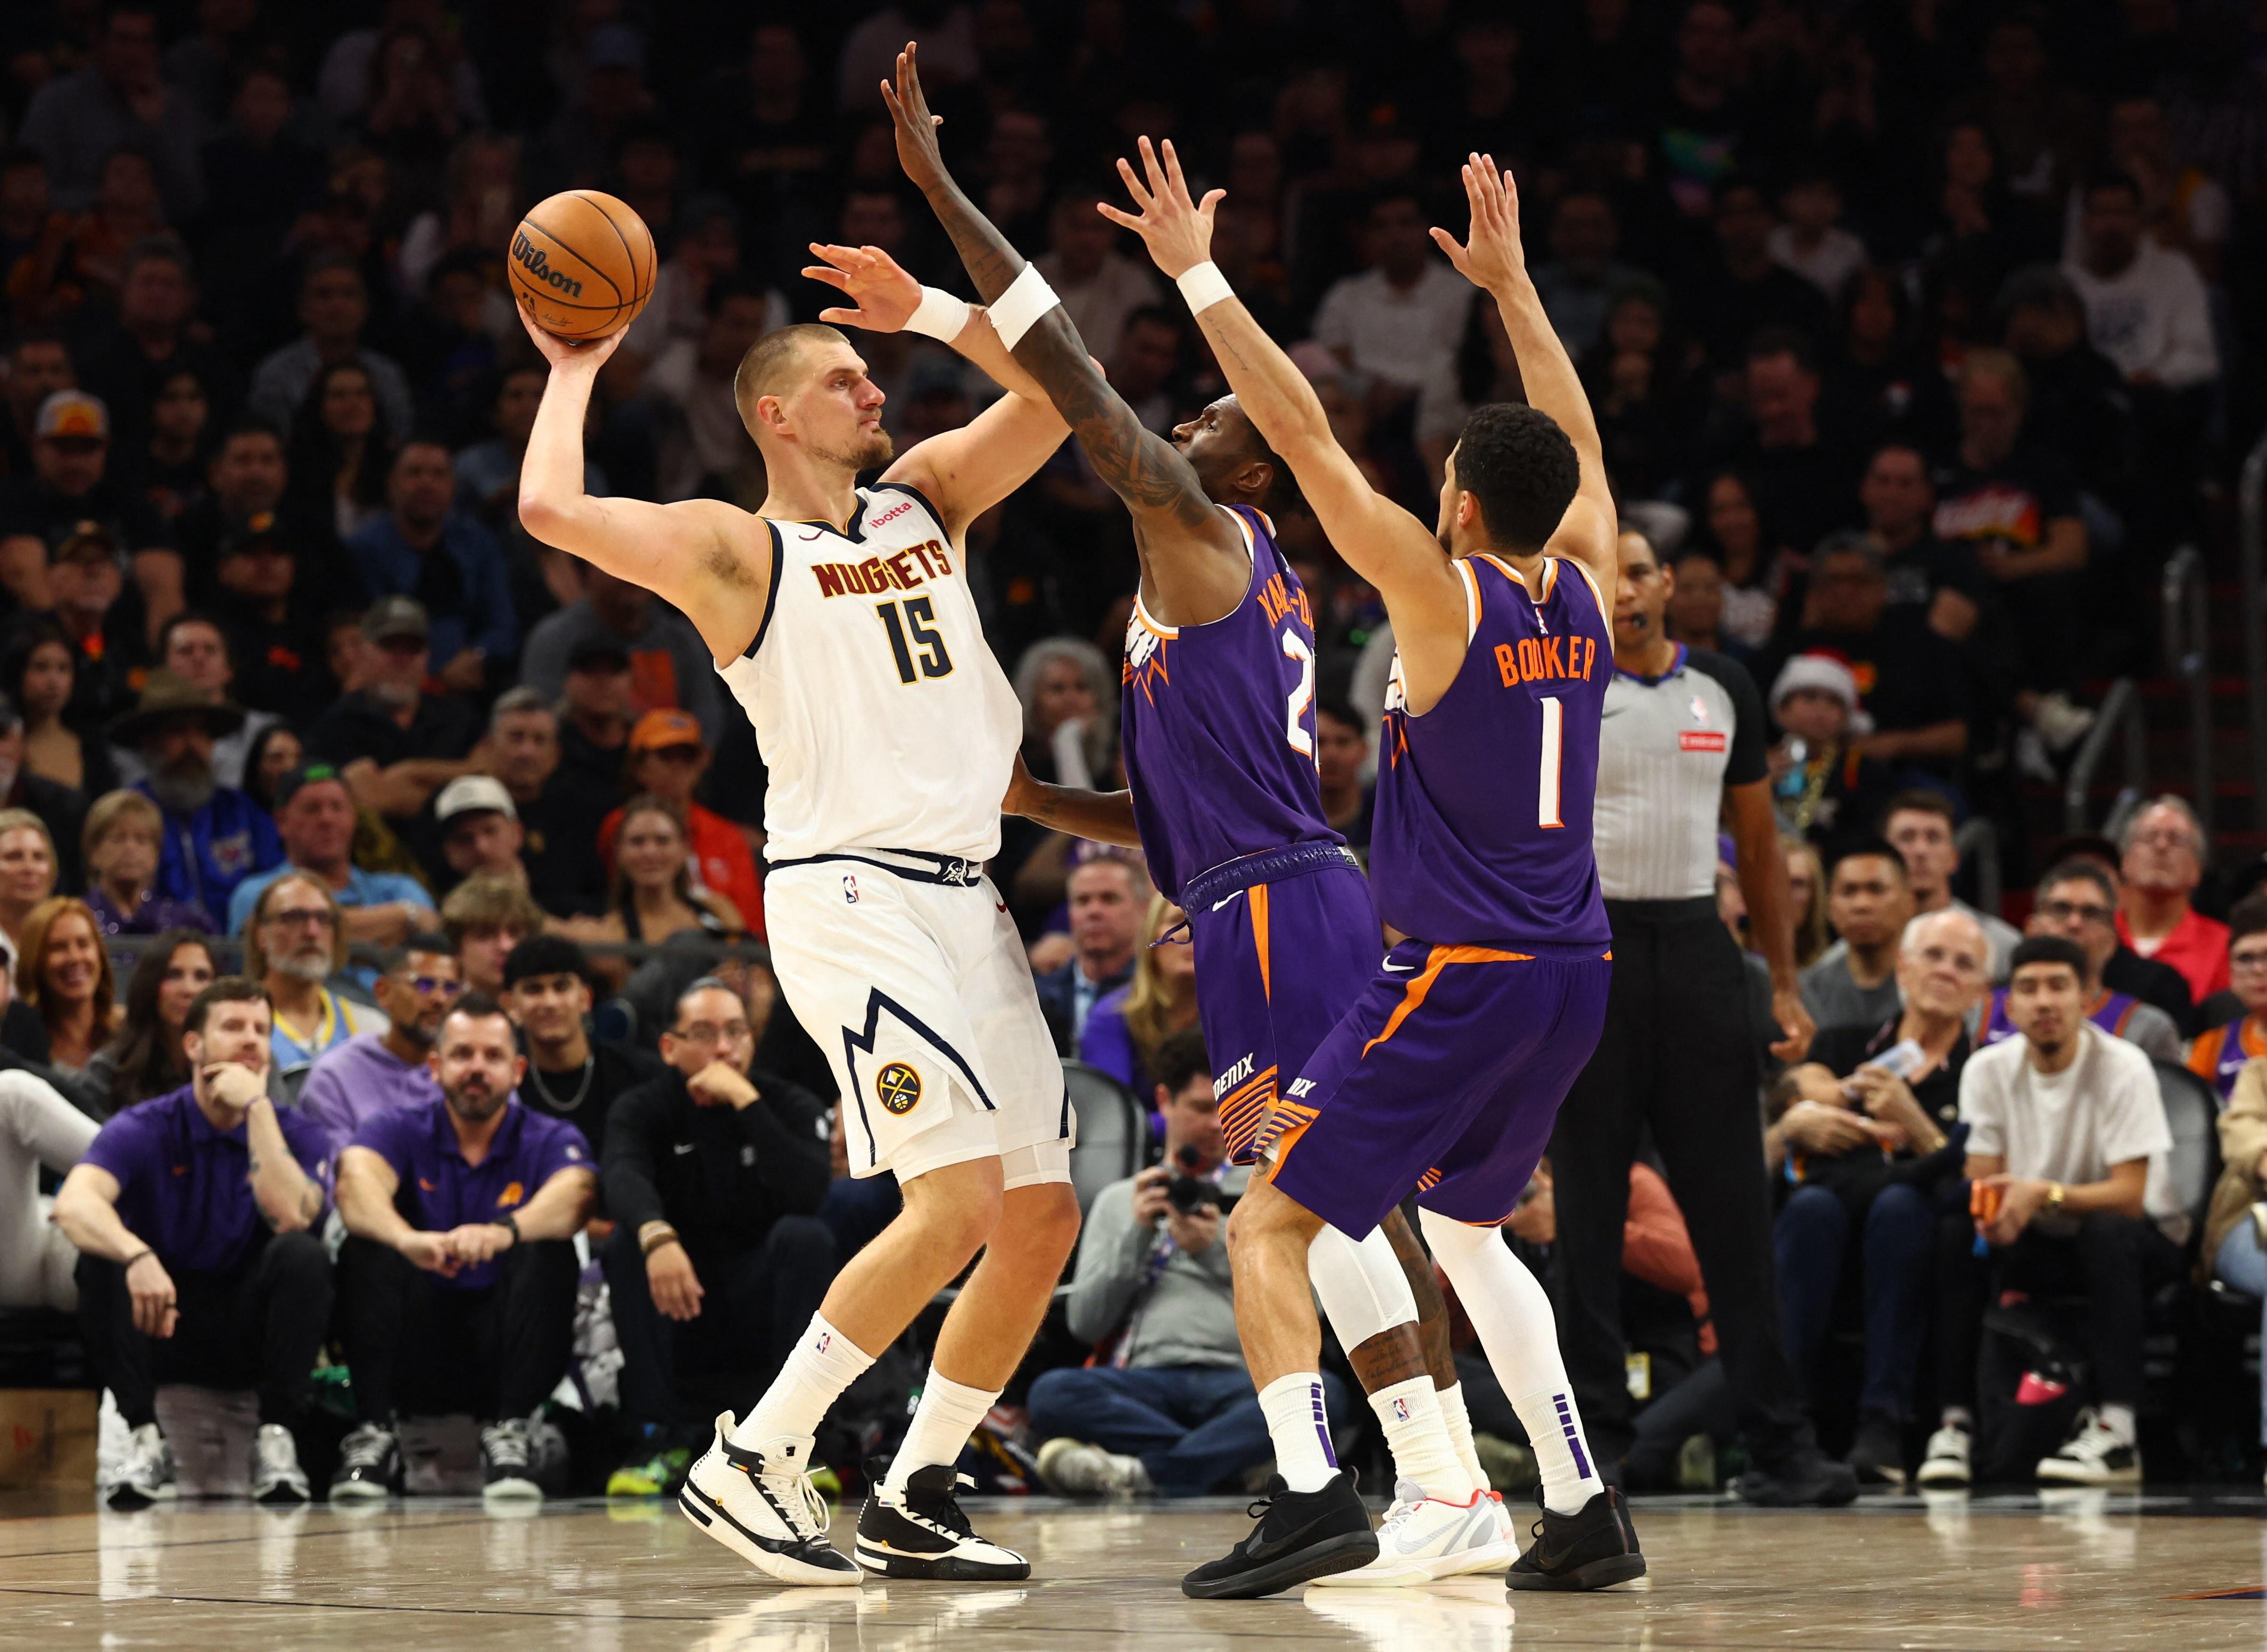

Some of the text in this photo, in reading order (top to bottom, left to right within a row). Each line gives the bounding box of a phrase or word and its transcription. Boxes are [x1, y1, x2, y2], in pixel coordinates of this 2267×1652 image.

[512, 229, 583, 299] Wilson
[868, 502, 913, 528] ibotta
[874, 594, 955, 686] 15
[1494, 635, 1595, 688] BOOKER
[1538, 697, 1565, 828] 1
